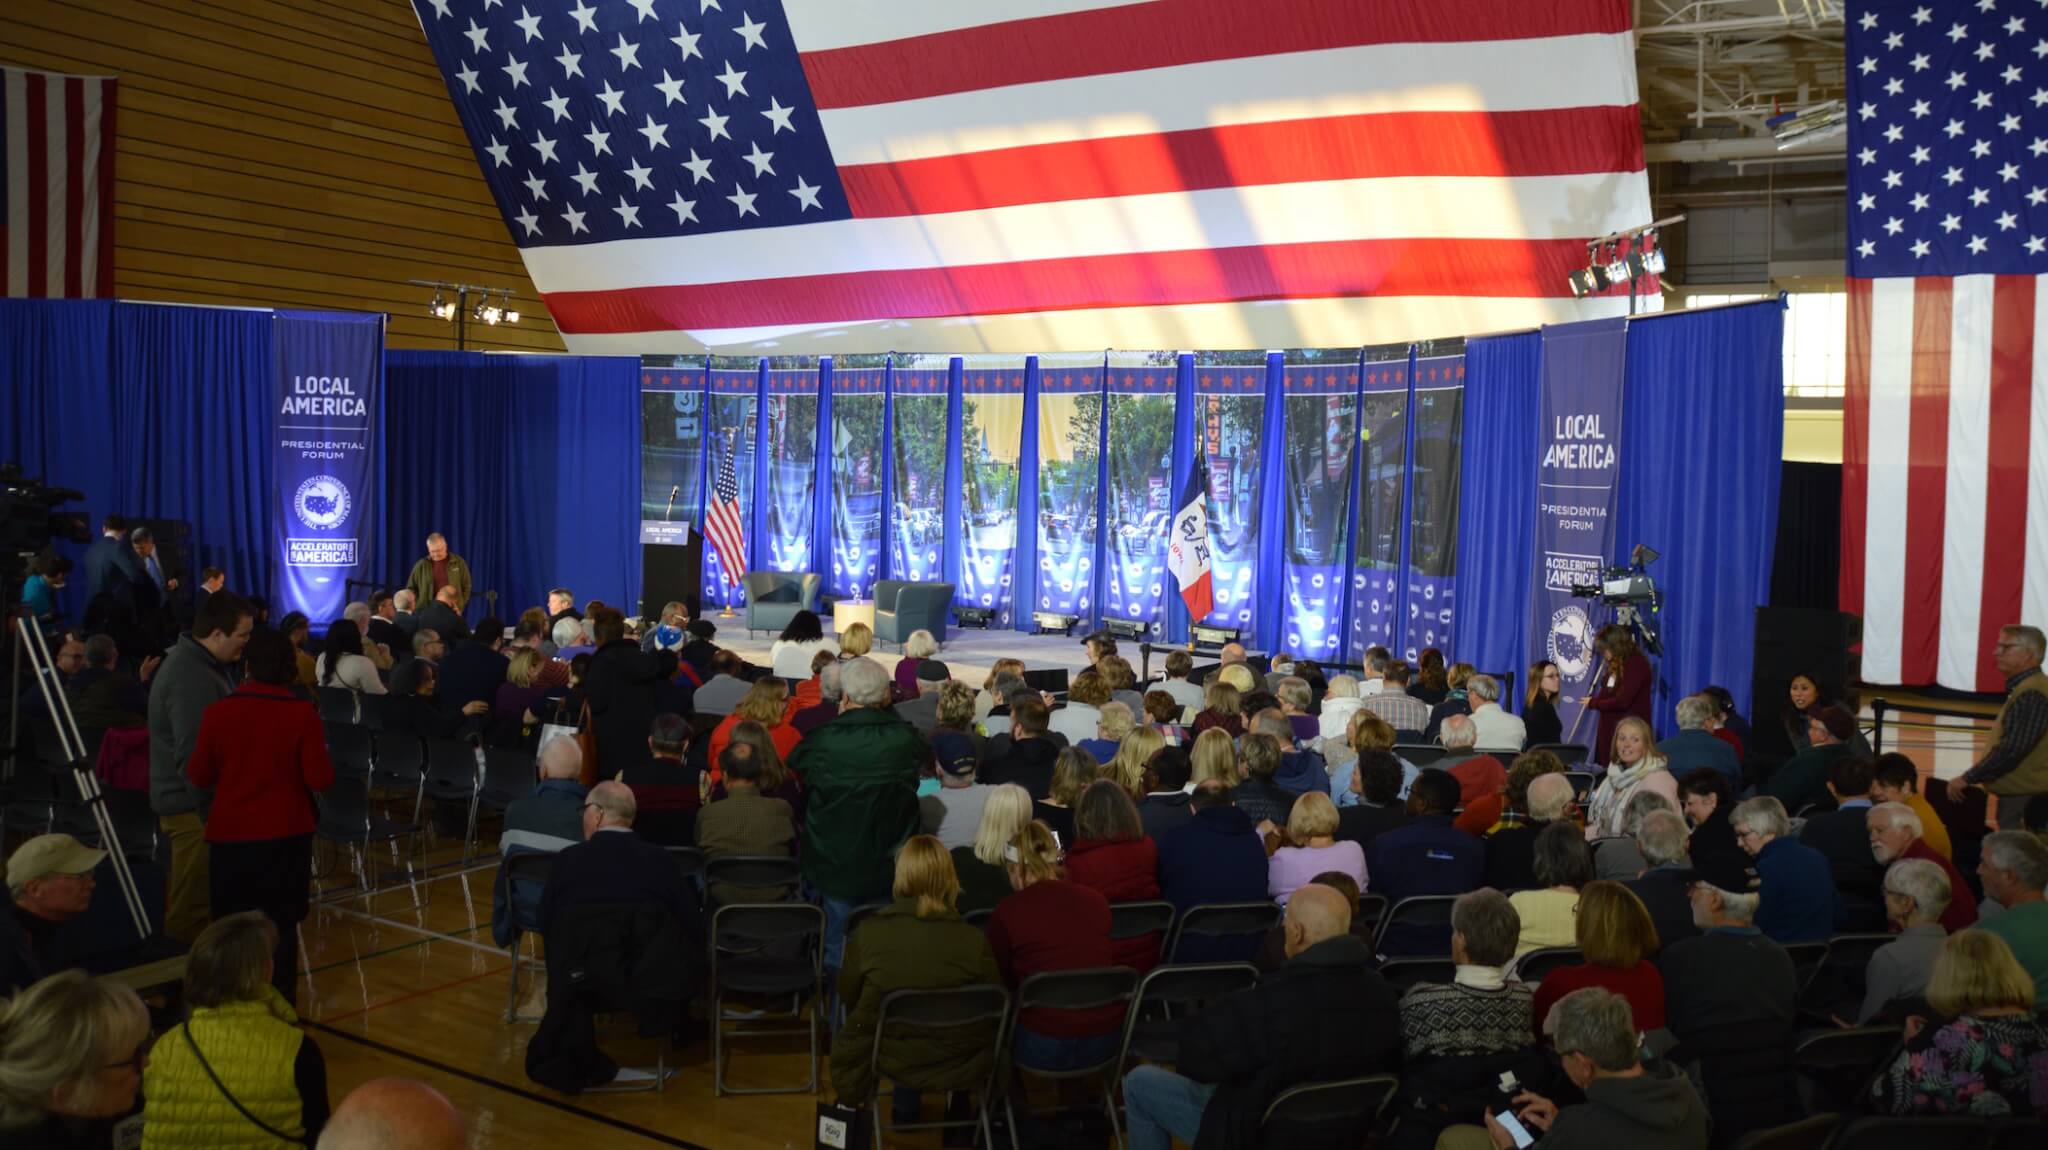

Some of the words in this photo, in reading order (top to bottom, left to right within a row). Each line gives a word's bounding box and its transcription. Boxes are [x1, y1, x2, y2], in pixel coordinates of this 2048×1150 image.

[295, 376, 355, 395] LOCAL
[281, 396, 367, 416] AMERICA
[1555, 414, 1605, 439] LOCAL
[281, 440, 365, 450] PRESIDENTIAL
[302, 451, 344, 459] FORUM
[1542, 444, 1615, 469] AMERICA
[1541, 504, 1607, 517] PRESIDENTIA
[1559, 520, 1593, 531] FORUM
[290, 542, 348, 551] ACCELERATOR
[296, 551, 348, 562] AMERICA
[1550, 569, 1594, 587] AMERICA
